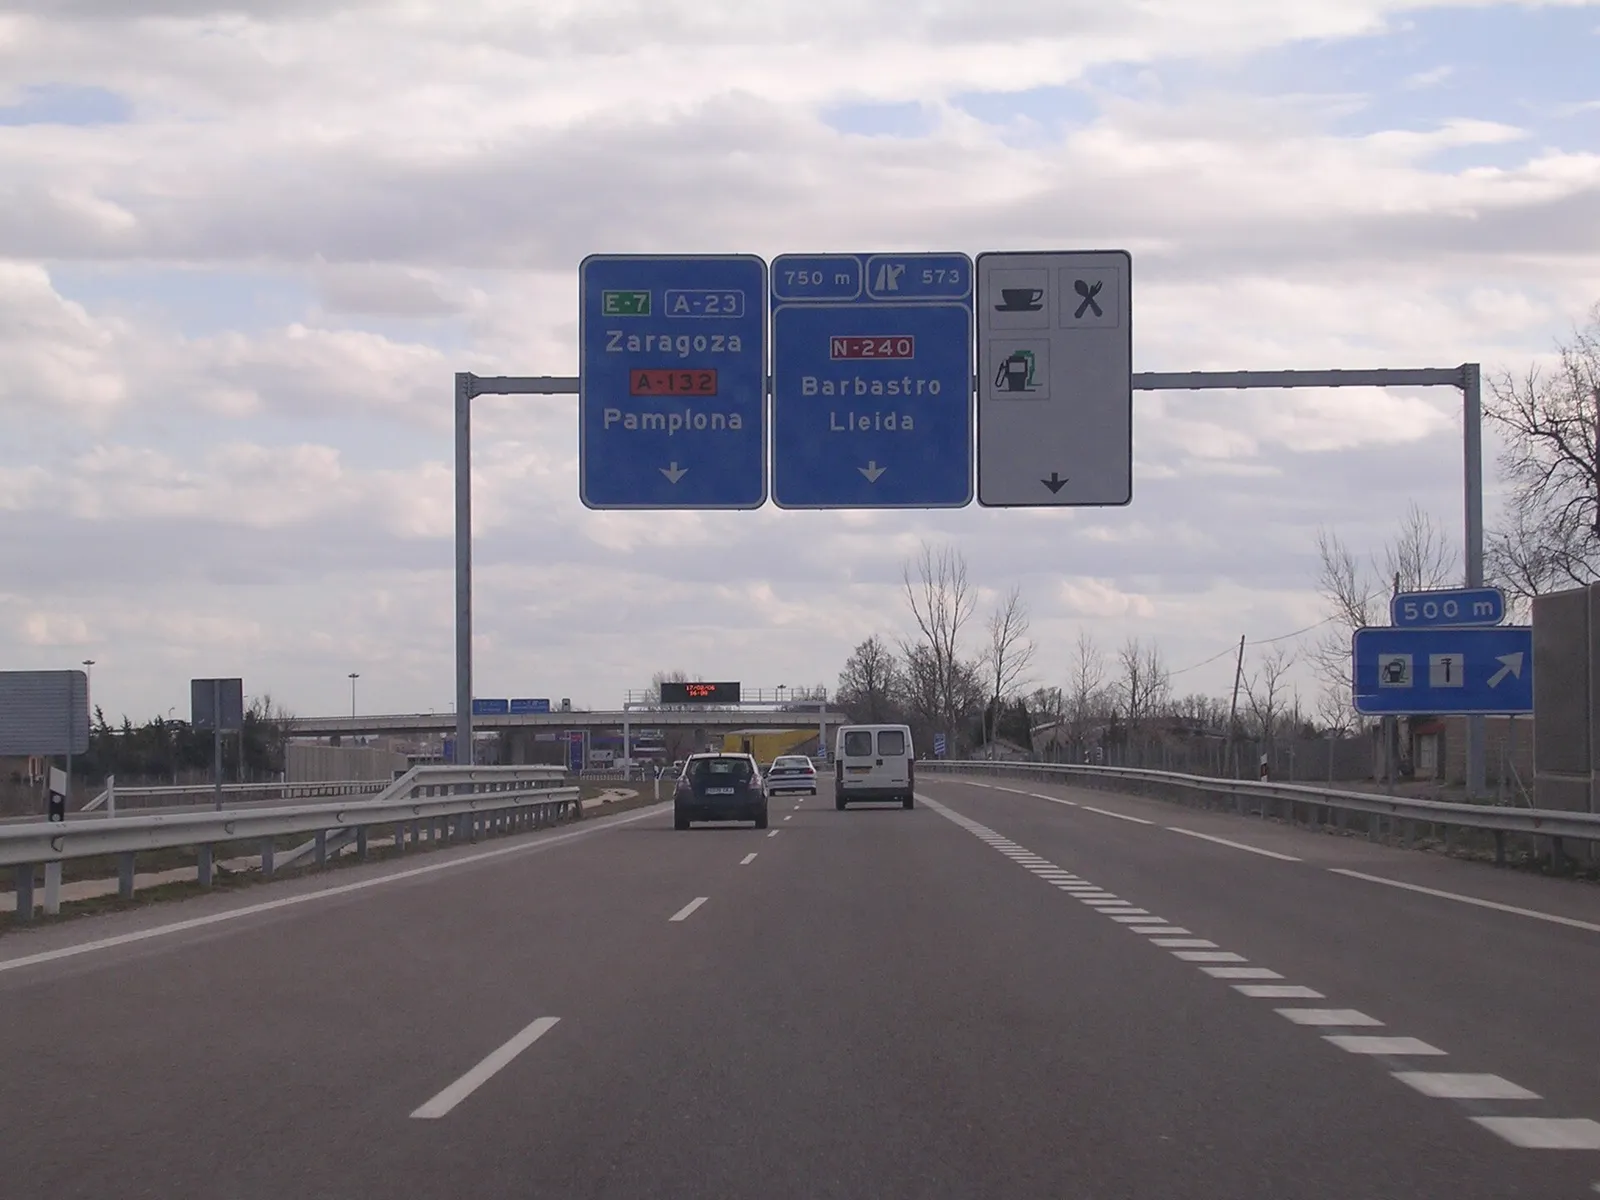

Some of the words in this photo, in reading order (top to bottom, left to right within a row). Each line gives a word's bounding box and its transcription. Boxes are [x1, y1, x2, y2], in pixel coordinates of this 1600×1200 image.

[784, 270, 824, 285] 750
[834, 273, 850, 285] m
[922, 269, 960, 284] 573
[605, 293, 647, 312] E-7
[673, 294, 737, 313] A-23
[605, 329, 742, 357] Zaragoza
[833, 339, 911, 357] N-240
[636, 373, 711, 392] A-132
[801, 376, 941, 396] Barbastro
[603, 408, 743, 436] Pamplona
[829, 411, 914, 431] Lleida
[1404, 600, 1459, 620] 500
[1473, 601, 1494, 617] m
